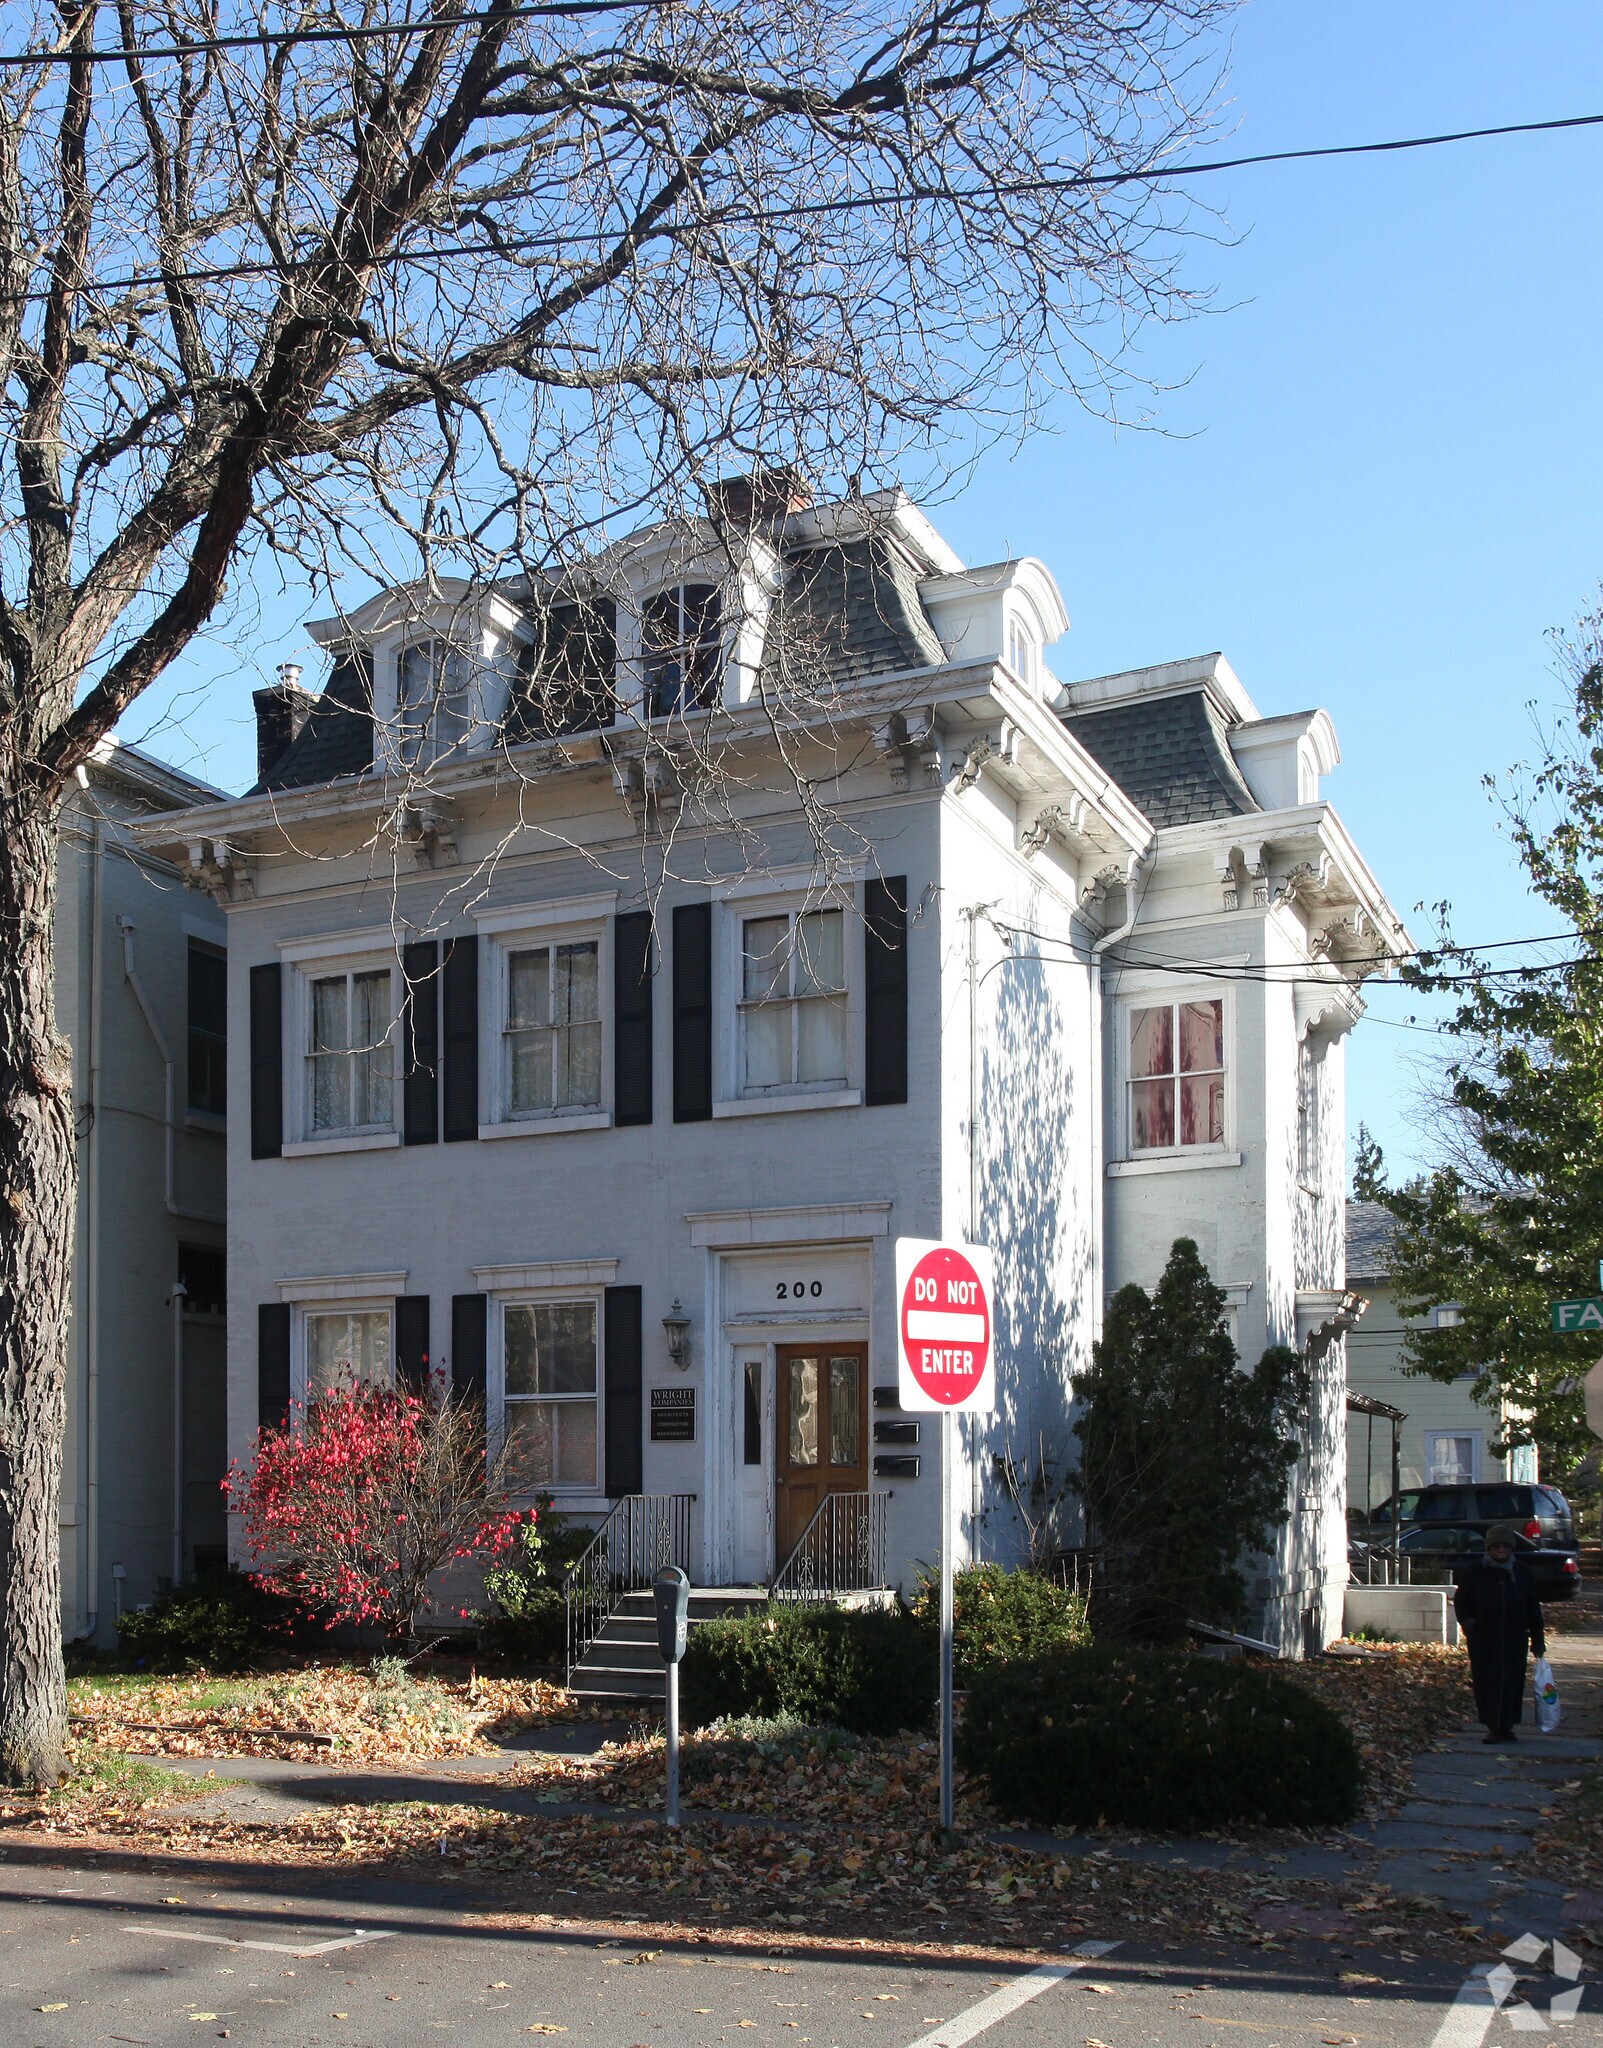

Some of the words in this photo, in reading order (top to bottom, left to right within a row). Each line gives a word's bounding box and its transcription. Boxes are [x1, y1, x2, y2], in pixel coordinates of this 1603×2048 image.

[776, 1281, 823, 1299] 200
[915, 1277, 938, 1302] DO
[947, 1280, 978, 1305] NOT
[921, 1348, 974, 1375] ENTER
[653, 1390, 693, 1399] WRIGHT
